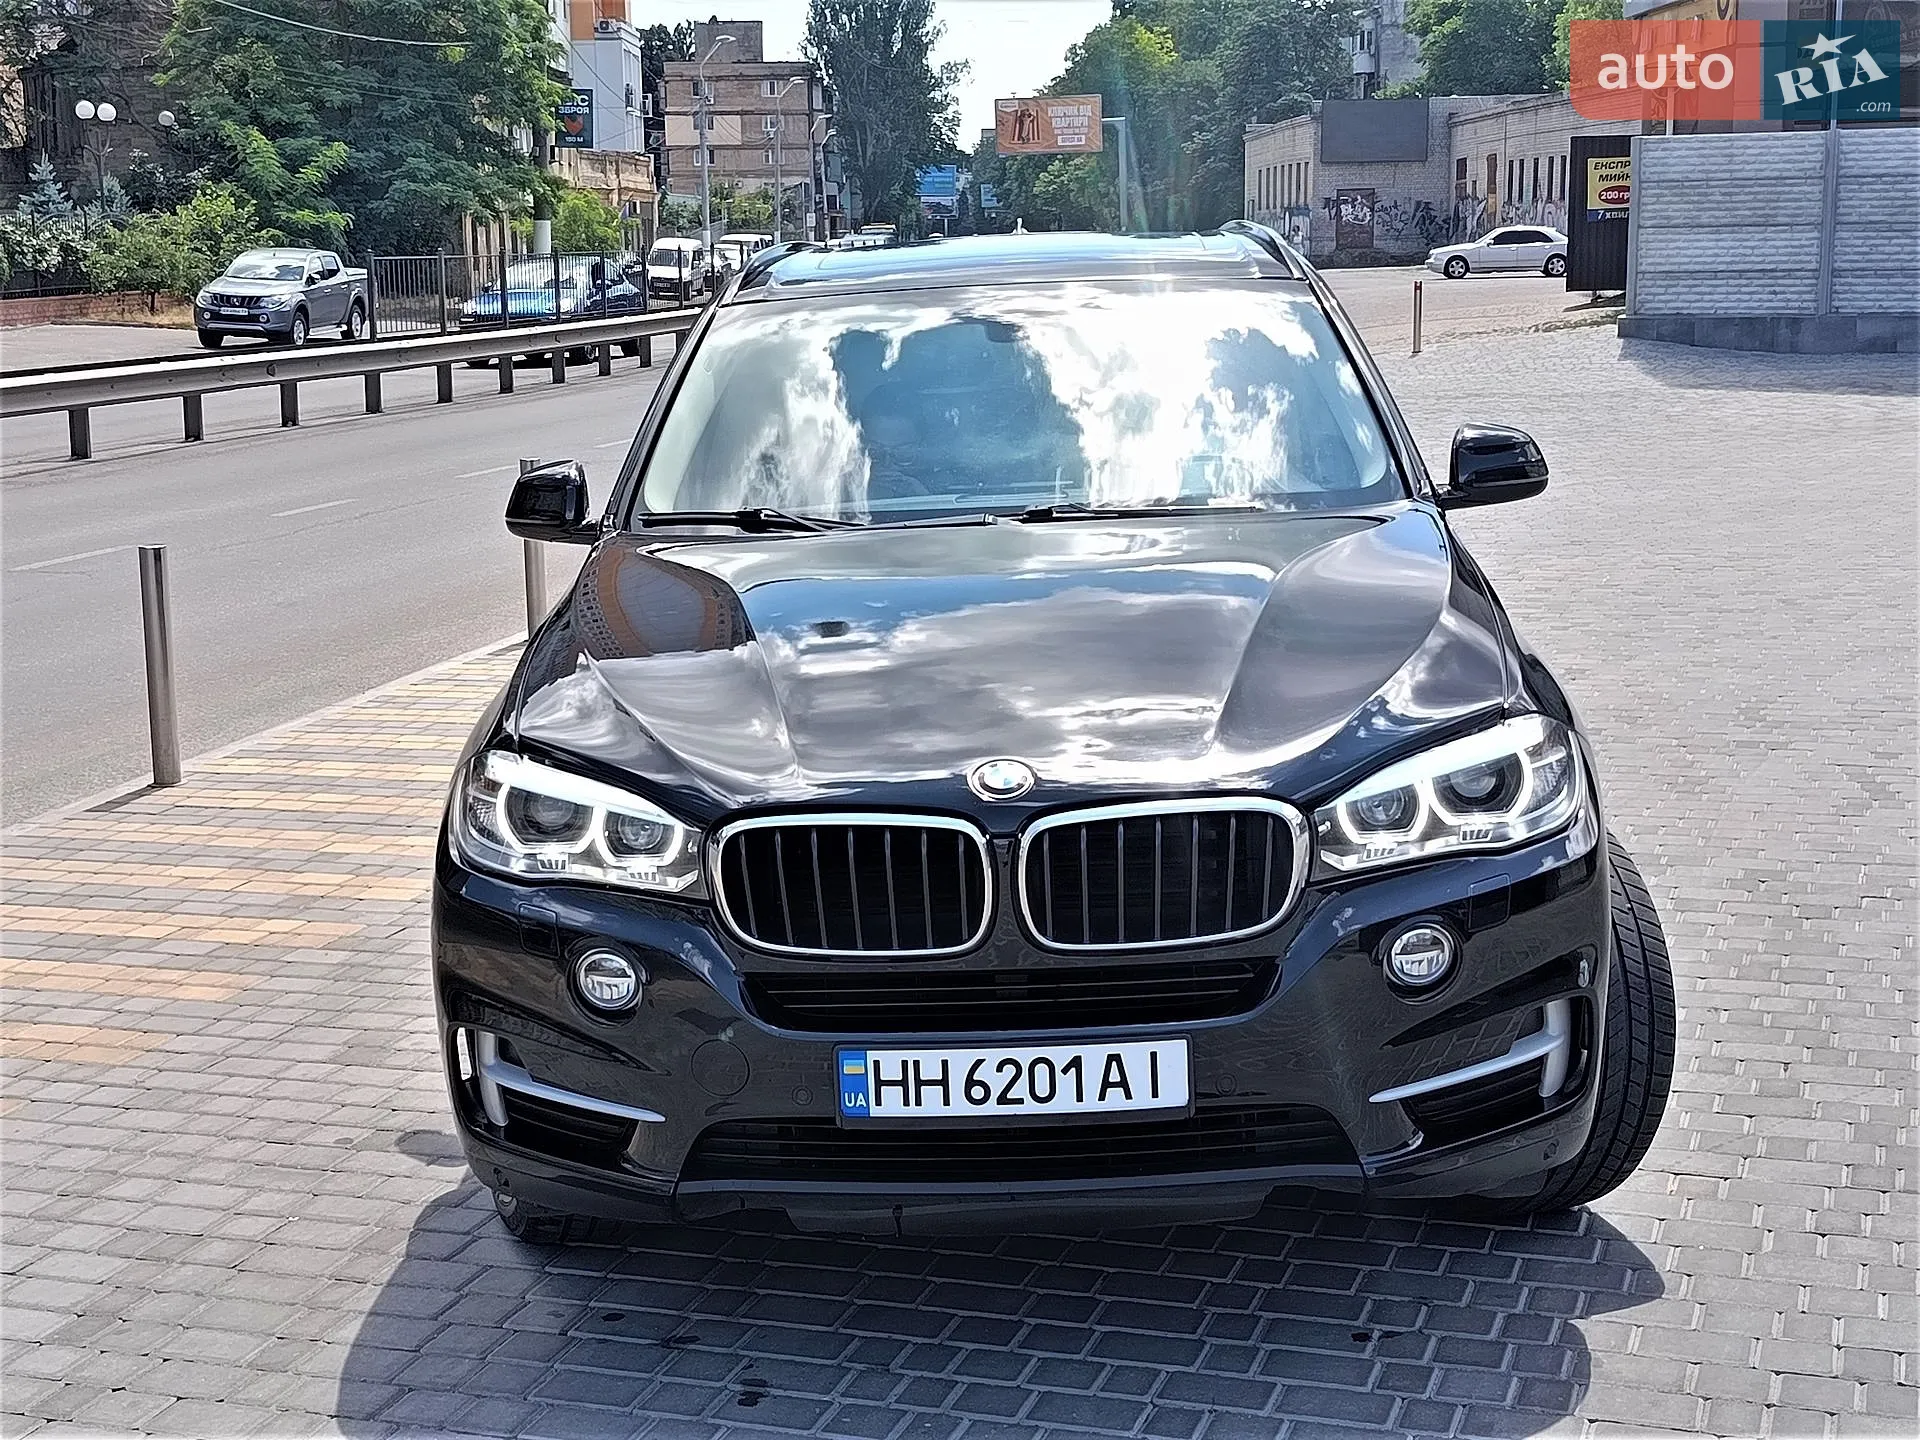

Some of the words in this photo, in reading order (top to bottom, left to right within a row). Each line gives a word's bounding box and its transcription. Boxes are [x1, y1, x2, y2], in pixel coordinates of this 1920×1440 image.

[558, 106, 590, 114] ЗБРОЯ
[1600, 191, 1619, 200] 200
[1597, 210, 1605, 220] 7
[844, 1091, 867, 1108] UA
